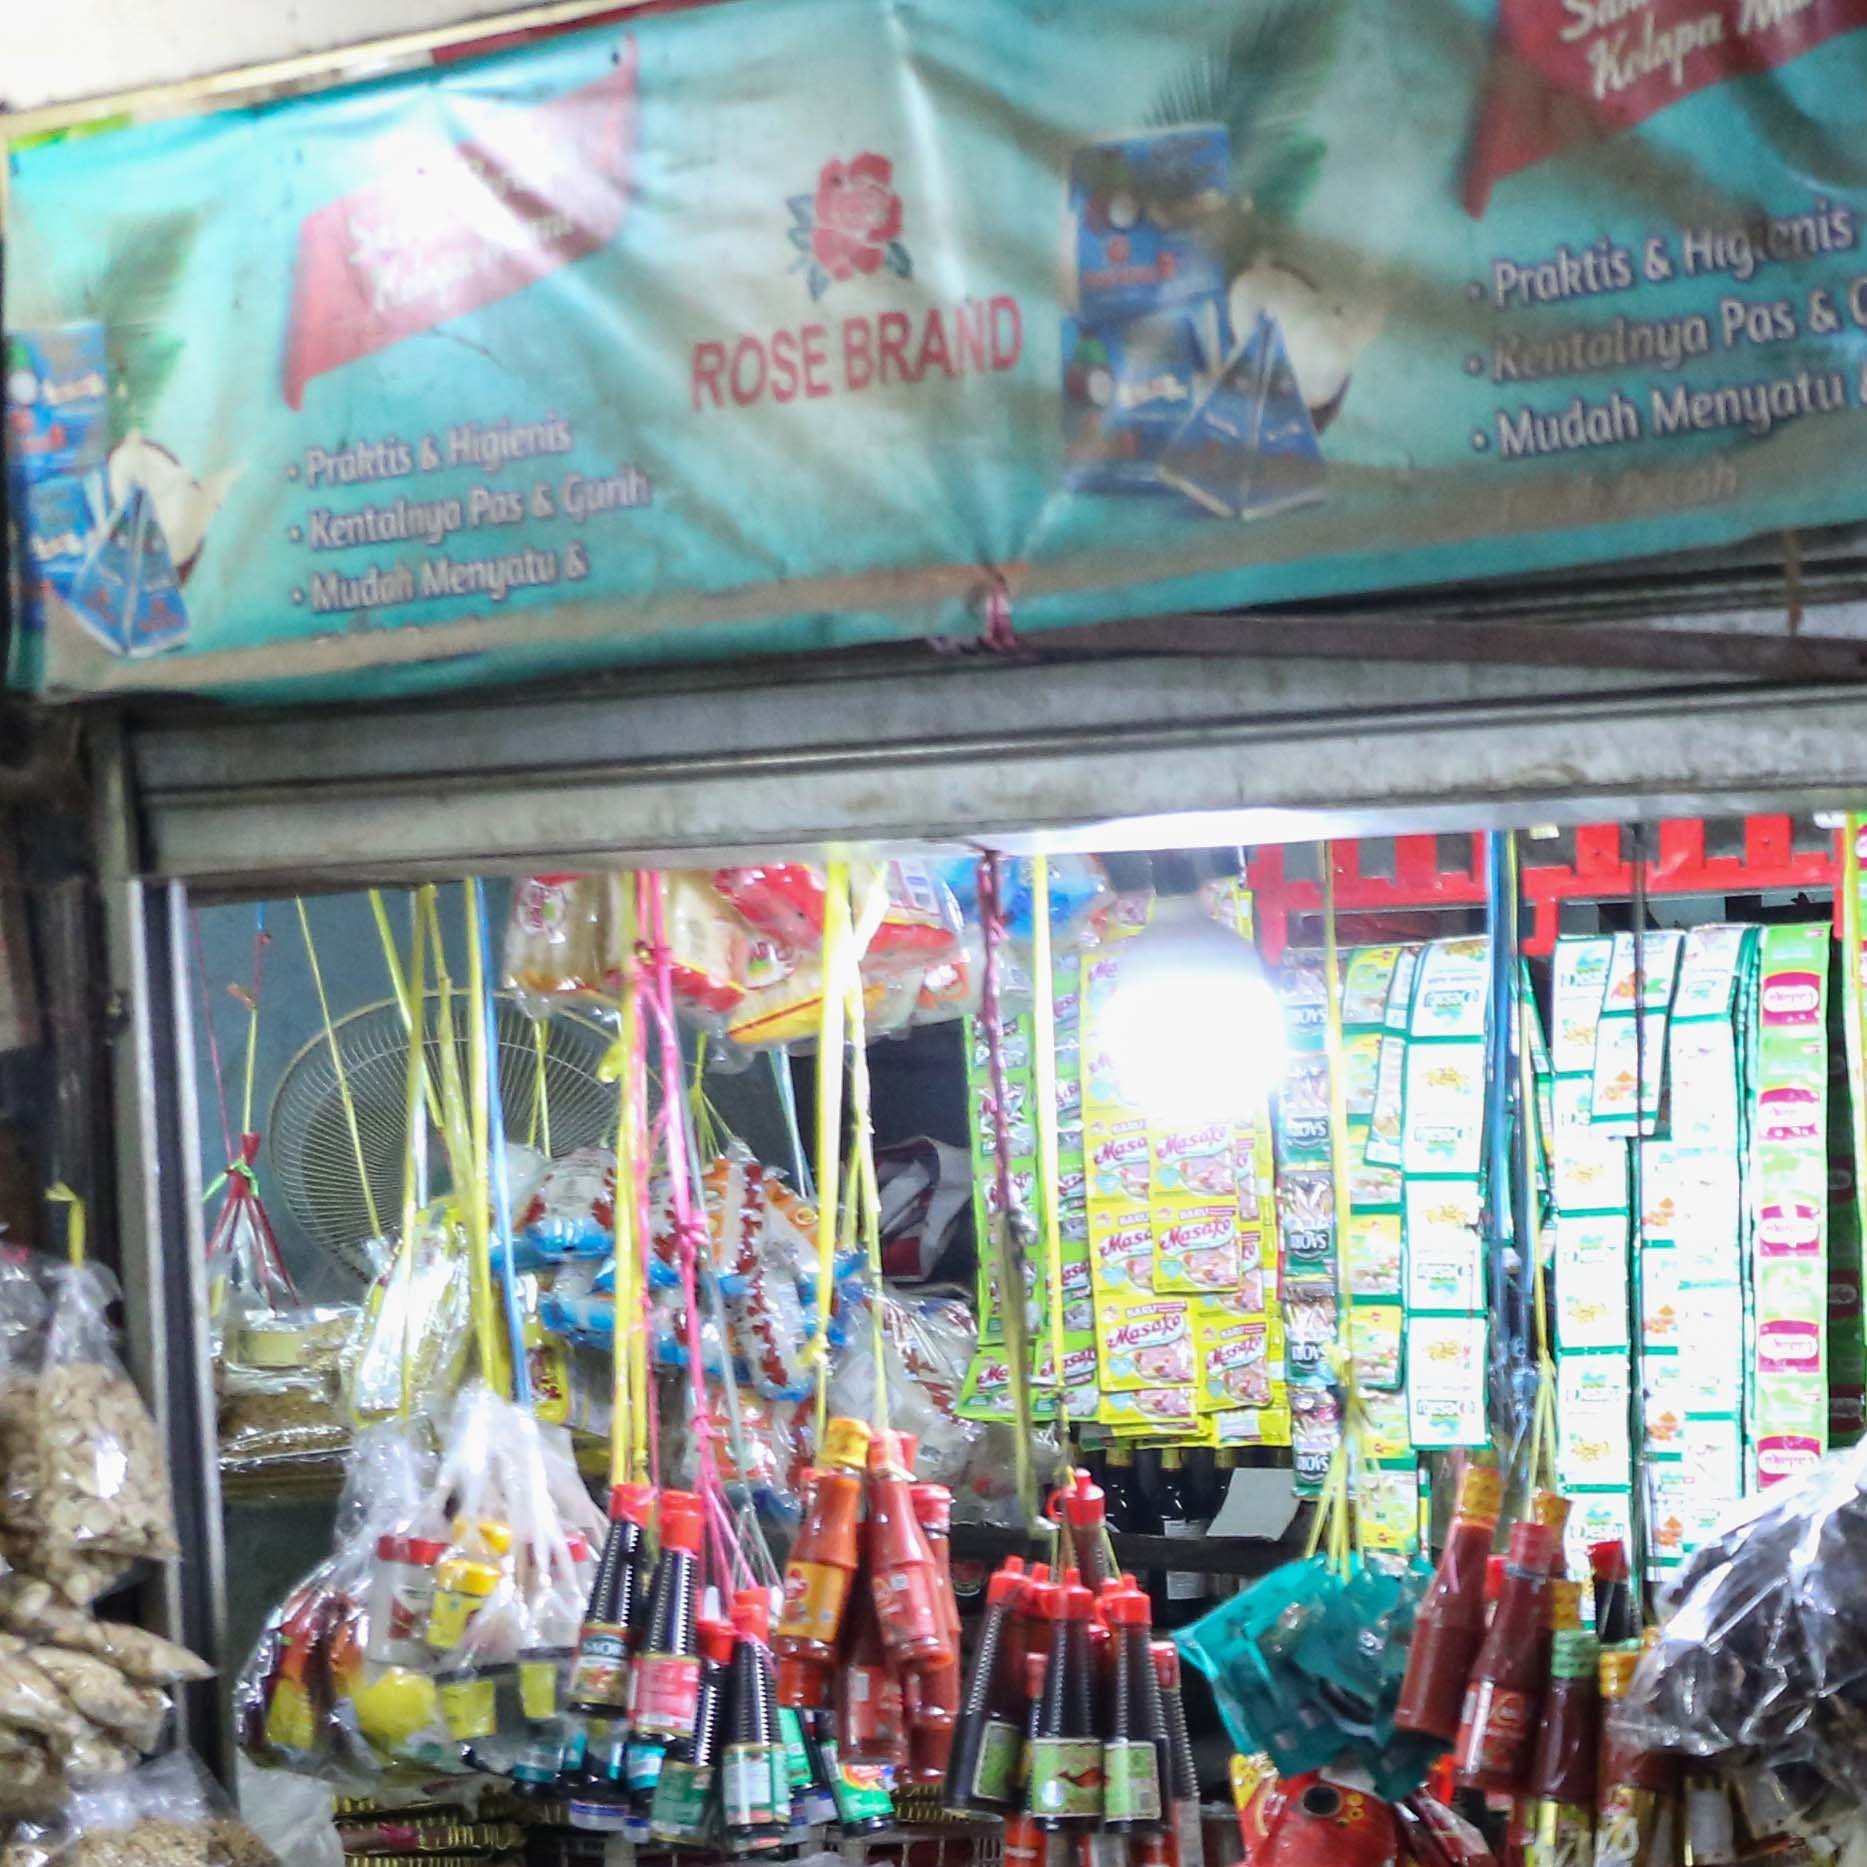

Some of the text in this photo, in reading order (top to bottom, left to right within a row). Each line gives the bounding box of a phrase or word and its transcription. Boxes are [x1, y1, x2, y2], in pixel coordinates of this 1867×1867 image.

[1588, 12, 1722, 100] Kelapa
[1492, 200, 1855, 308] Praktis & Higienis
[690, 297, 1024, 410] ROSE BRAND
[1494, 315, 1710, 383] Kentalnya
[1722, 298, 1796, 347] Pas
[1808, 289, 1837, 334] &
[1498, 402, 1639, 466] Mudah
[1652, 370, 1846, 436] Menyatu
[308, 438, 412, 486] Praktis
[309, 498, 460, 550] Kentalnya
[469, 486, 523, 526] Pas
[310, 564, 414, 612] Mudah
[421, 543, 555, 600] Menyatu
[1094, 1135, 1147, 1165] Masa
[1160, 1216, 1232, 1250] Masako
[1106, 1311, 1182, 1348] Masako
